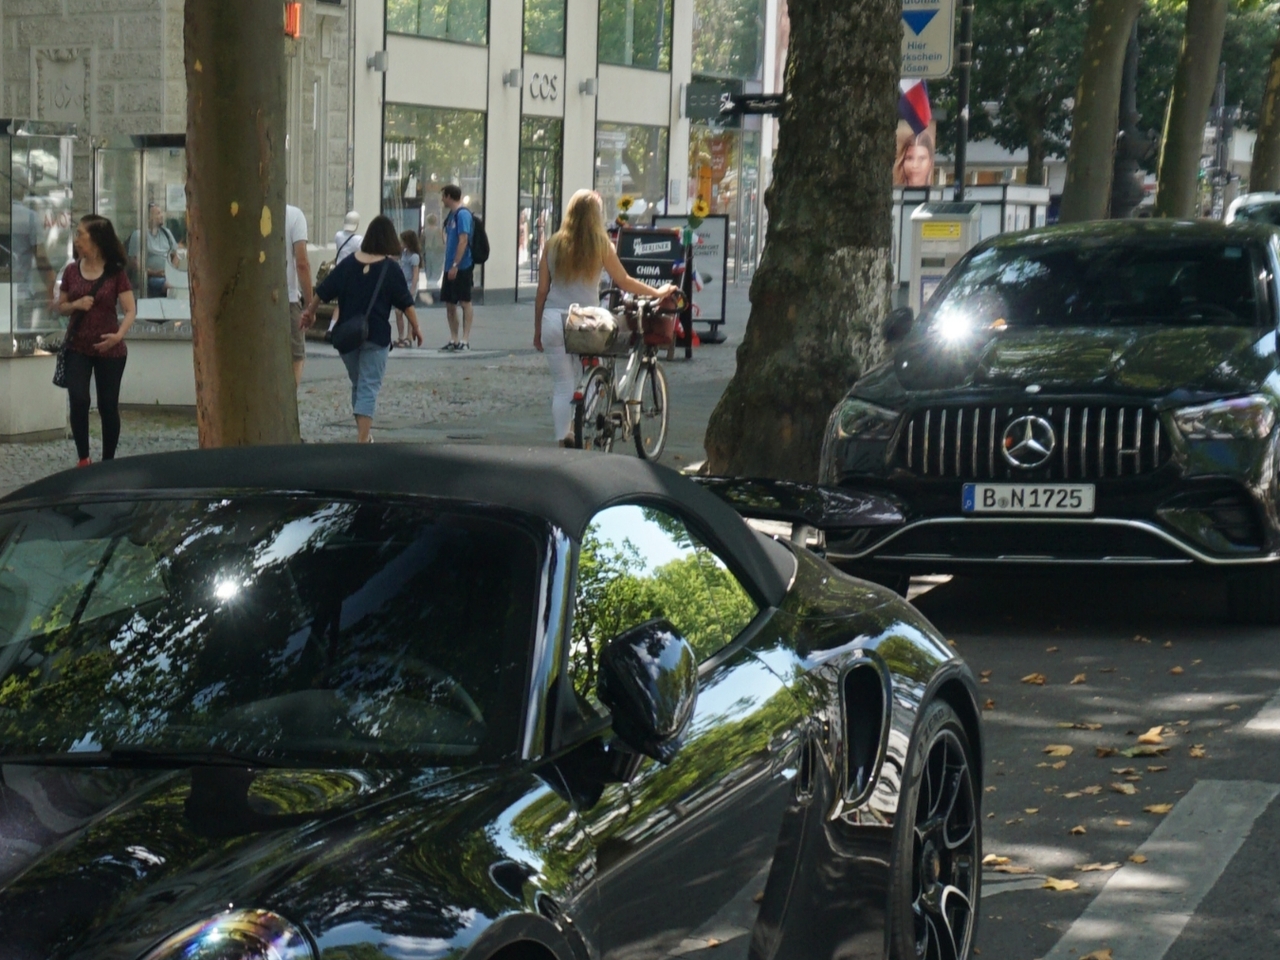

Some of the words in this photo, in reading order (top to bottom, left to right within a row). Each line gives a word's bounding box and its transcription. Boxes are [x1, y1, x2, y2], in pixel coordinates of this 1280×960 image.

[530, 73, 558, 101] COS
[690, 95, 717, 106] COS
[636, 265, 660, 275] CHINA
[983, 488, 996, 508] B
[1011, 488, 1025, 508] N
[1029, 488, 1083, 508] 1725
